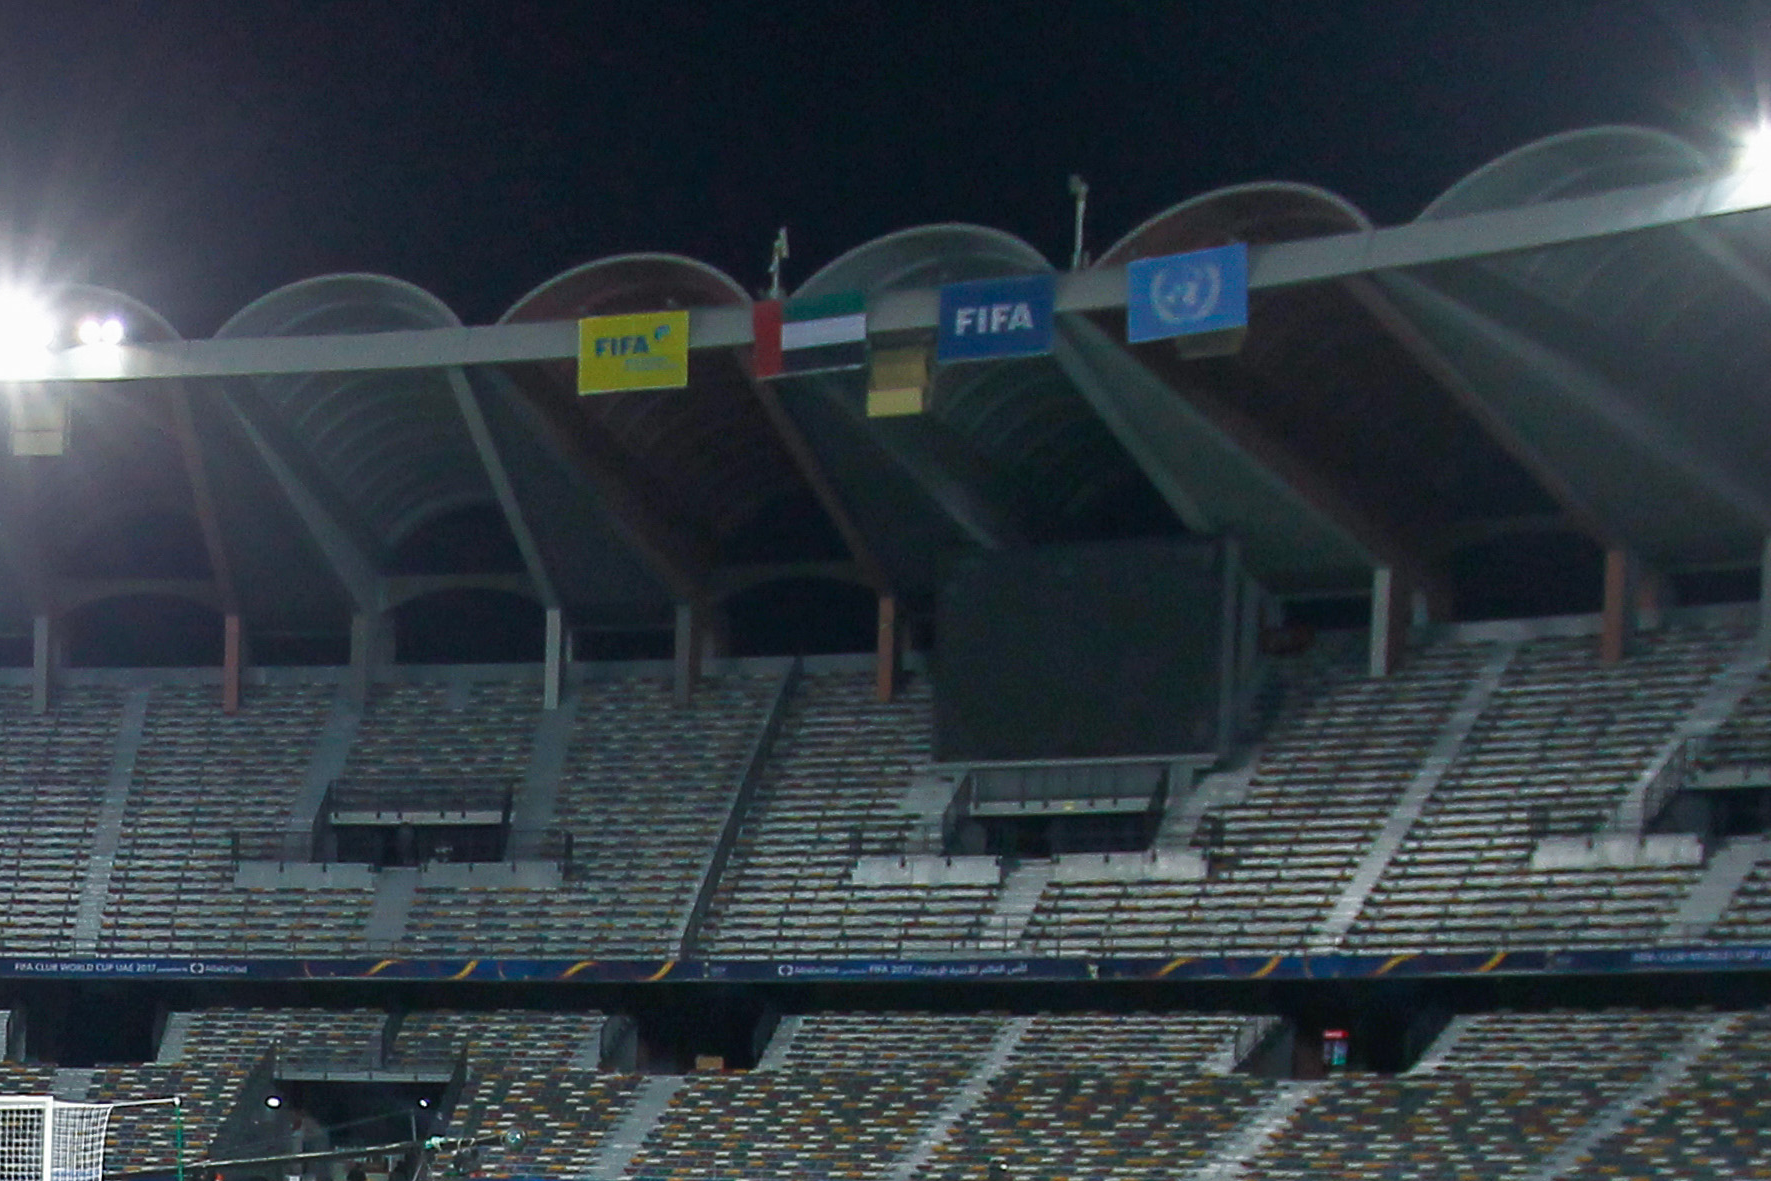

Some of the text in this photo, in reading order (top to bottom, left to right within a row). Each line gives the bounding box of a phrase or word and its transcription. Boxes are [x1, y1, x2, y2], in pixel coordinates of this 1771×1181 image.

[955, 302, 1035, 336] FIFA
[594, 336, 649, 357] FIFA
[15, 962, 34, 972] FIFA
[35, 962, 57, 972] CLUB
[60, 962, 94, 973] WORLD
[96, 962, 114, 973] CUP
[115, 962, 134, 973] UAE
[136, 962, 157, 973] 2017
